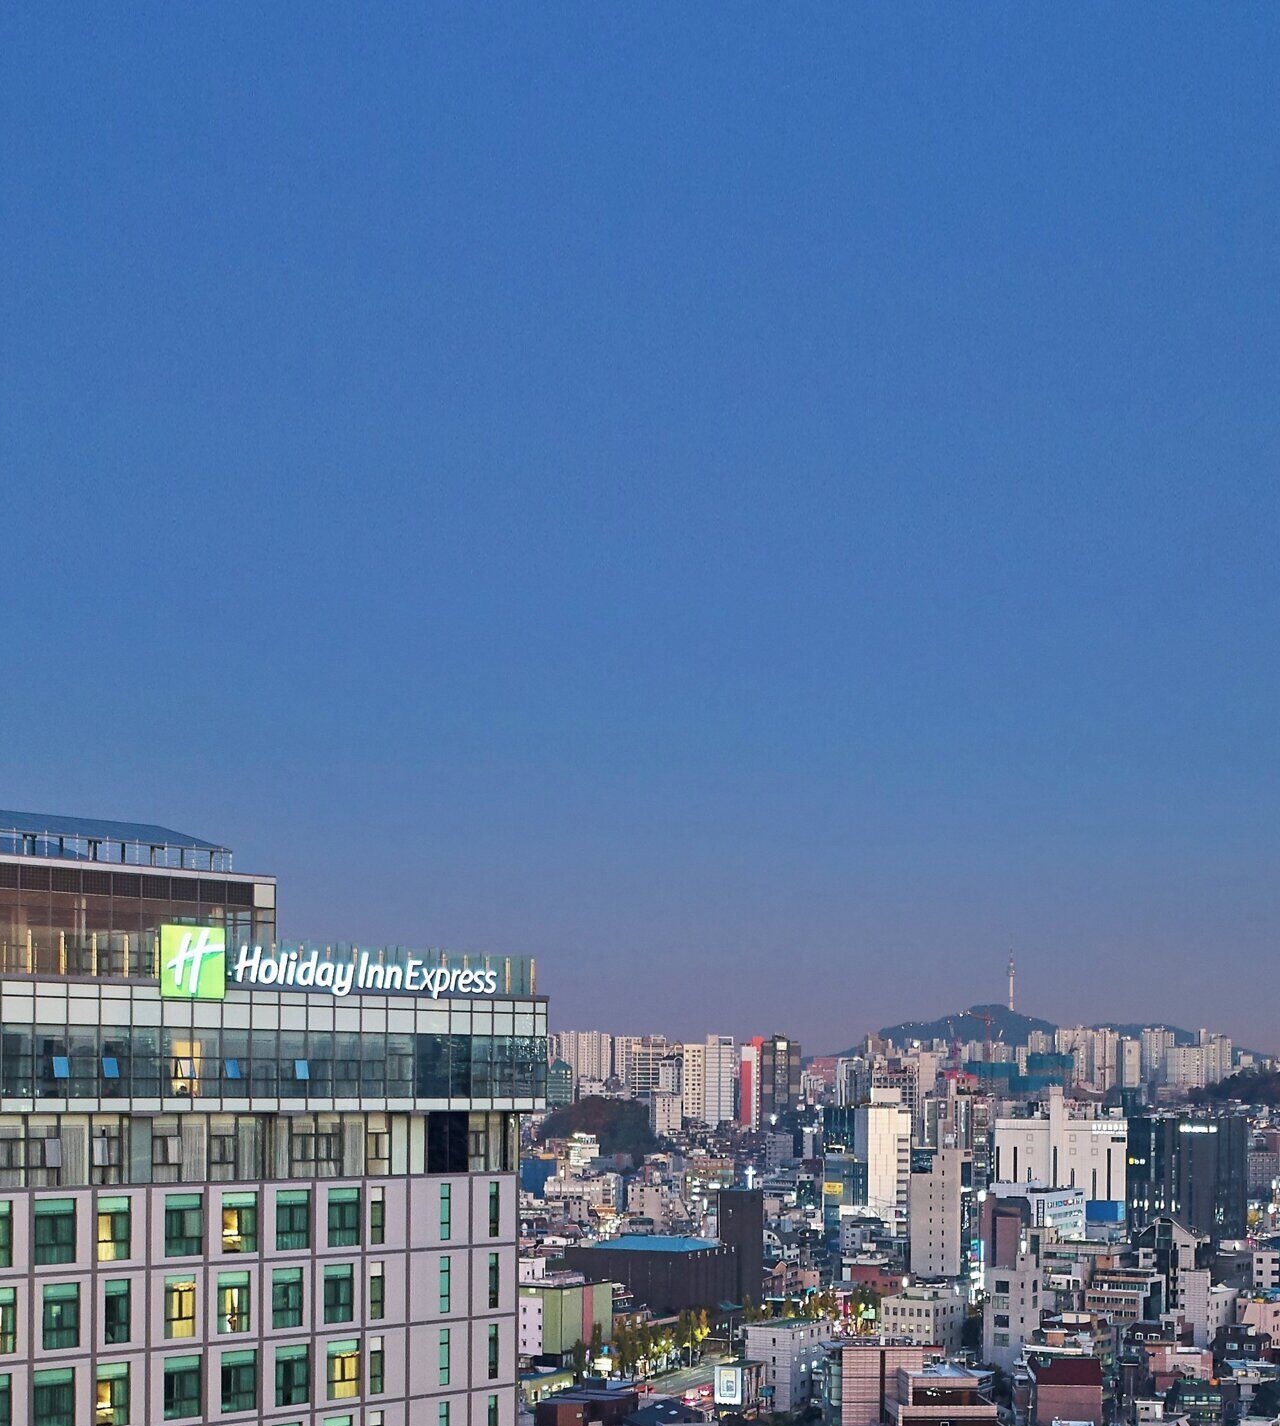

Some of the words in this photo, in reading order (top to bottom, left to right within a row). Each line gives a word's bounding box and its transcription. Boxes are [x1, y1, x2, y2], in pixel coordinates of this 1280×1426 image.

[234, 945, 355, 997] Holiday
[357, 951, 405, 990] Inn
[406, 960, 498, 999] Express
